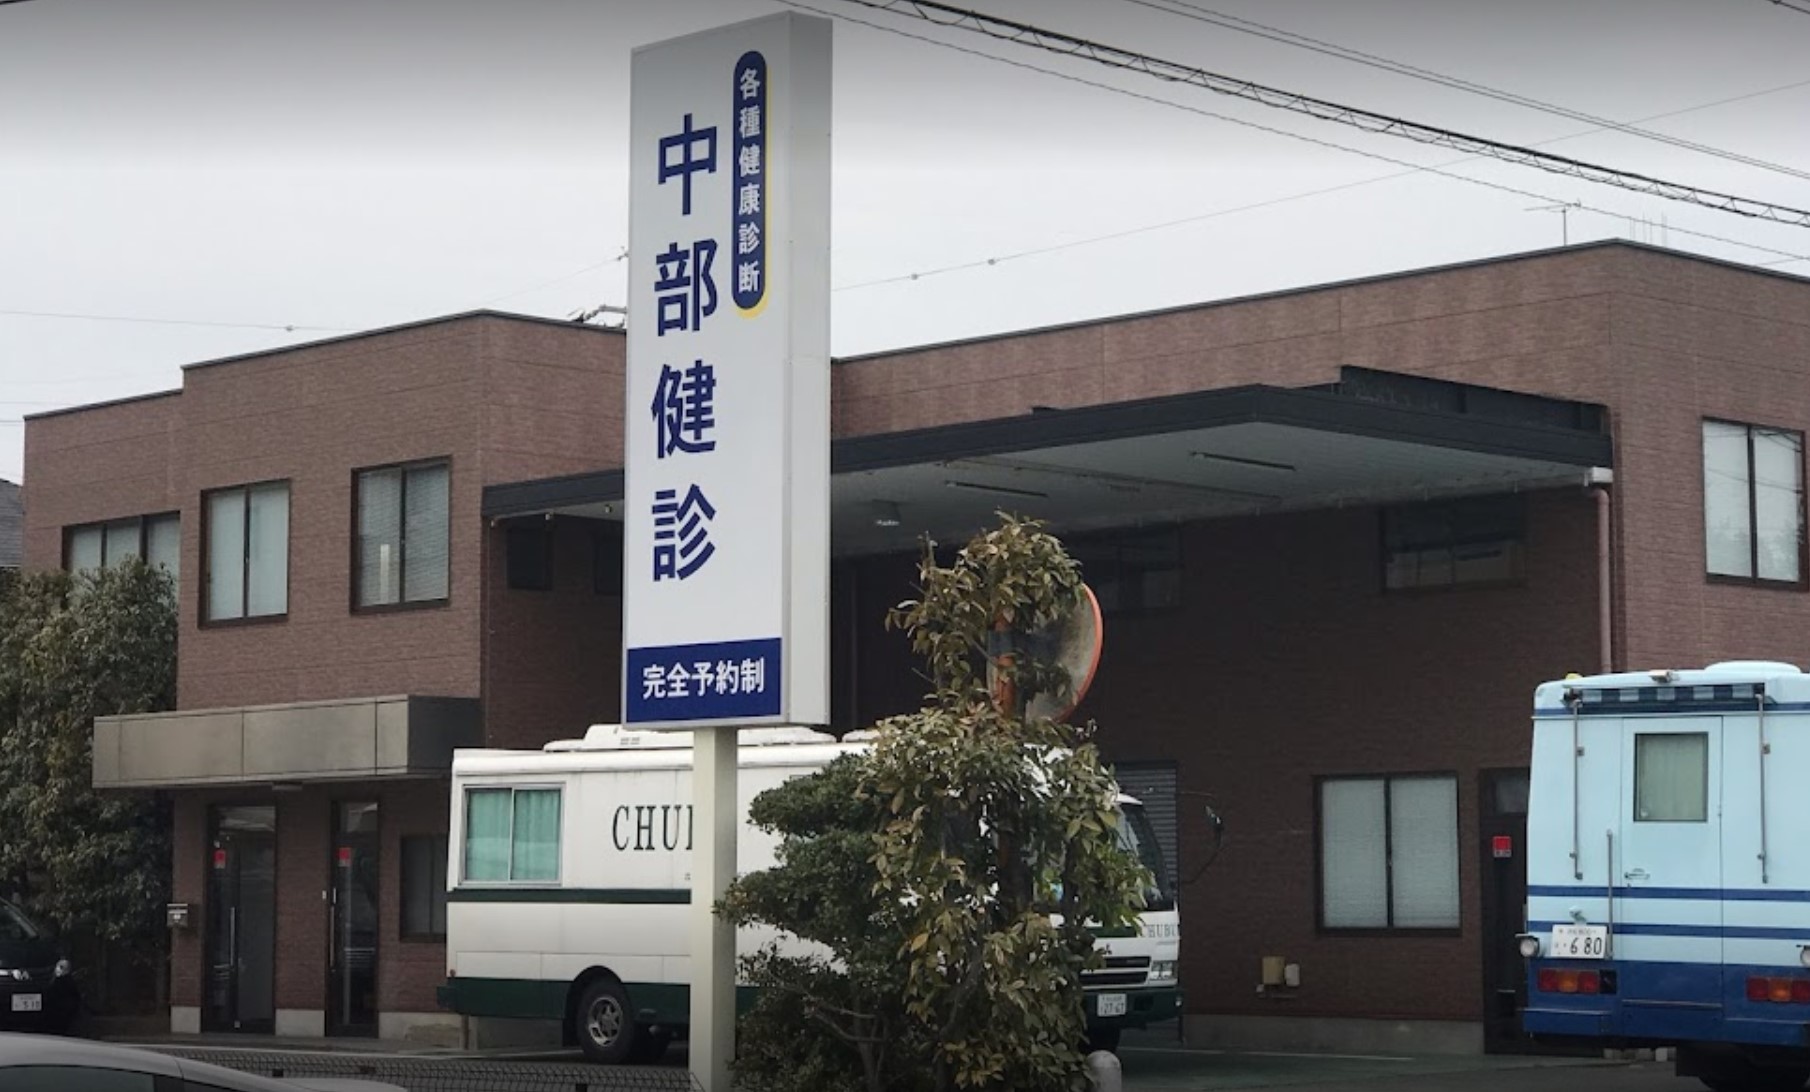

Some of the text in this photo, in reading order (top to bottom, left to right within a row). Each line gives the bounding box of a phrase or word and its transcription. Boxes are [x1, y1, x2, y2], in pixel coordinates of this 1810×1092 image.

[738, 68, 761, 294] 各種健康診断
[651, 113, 718, 582] 中部健診
[642, 656, 765, 700] 完全予約制
